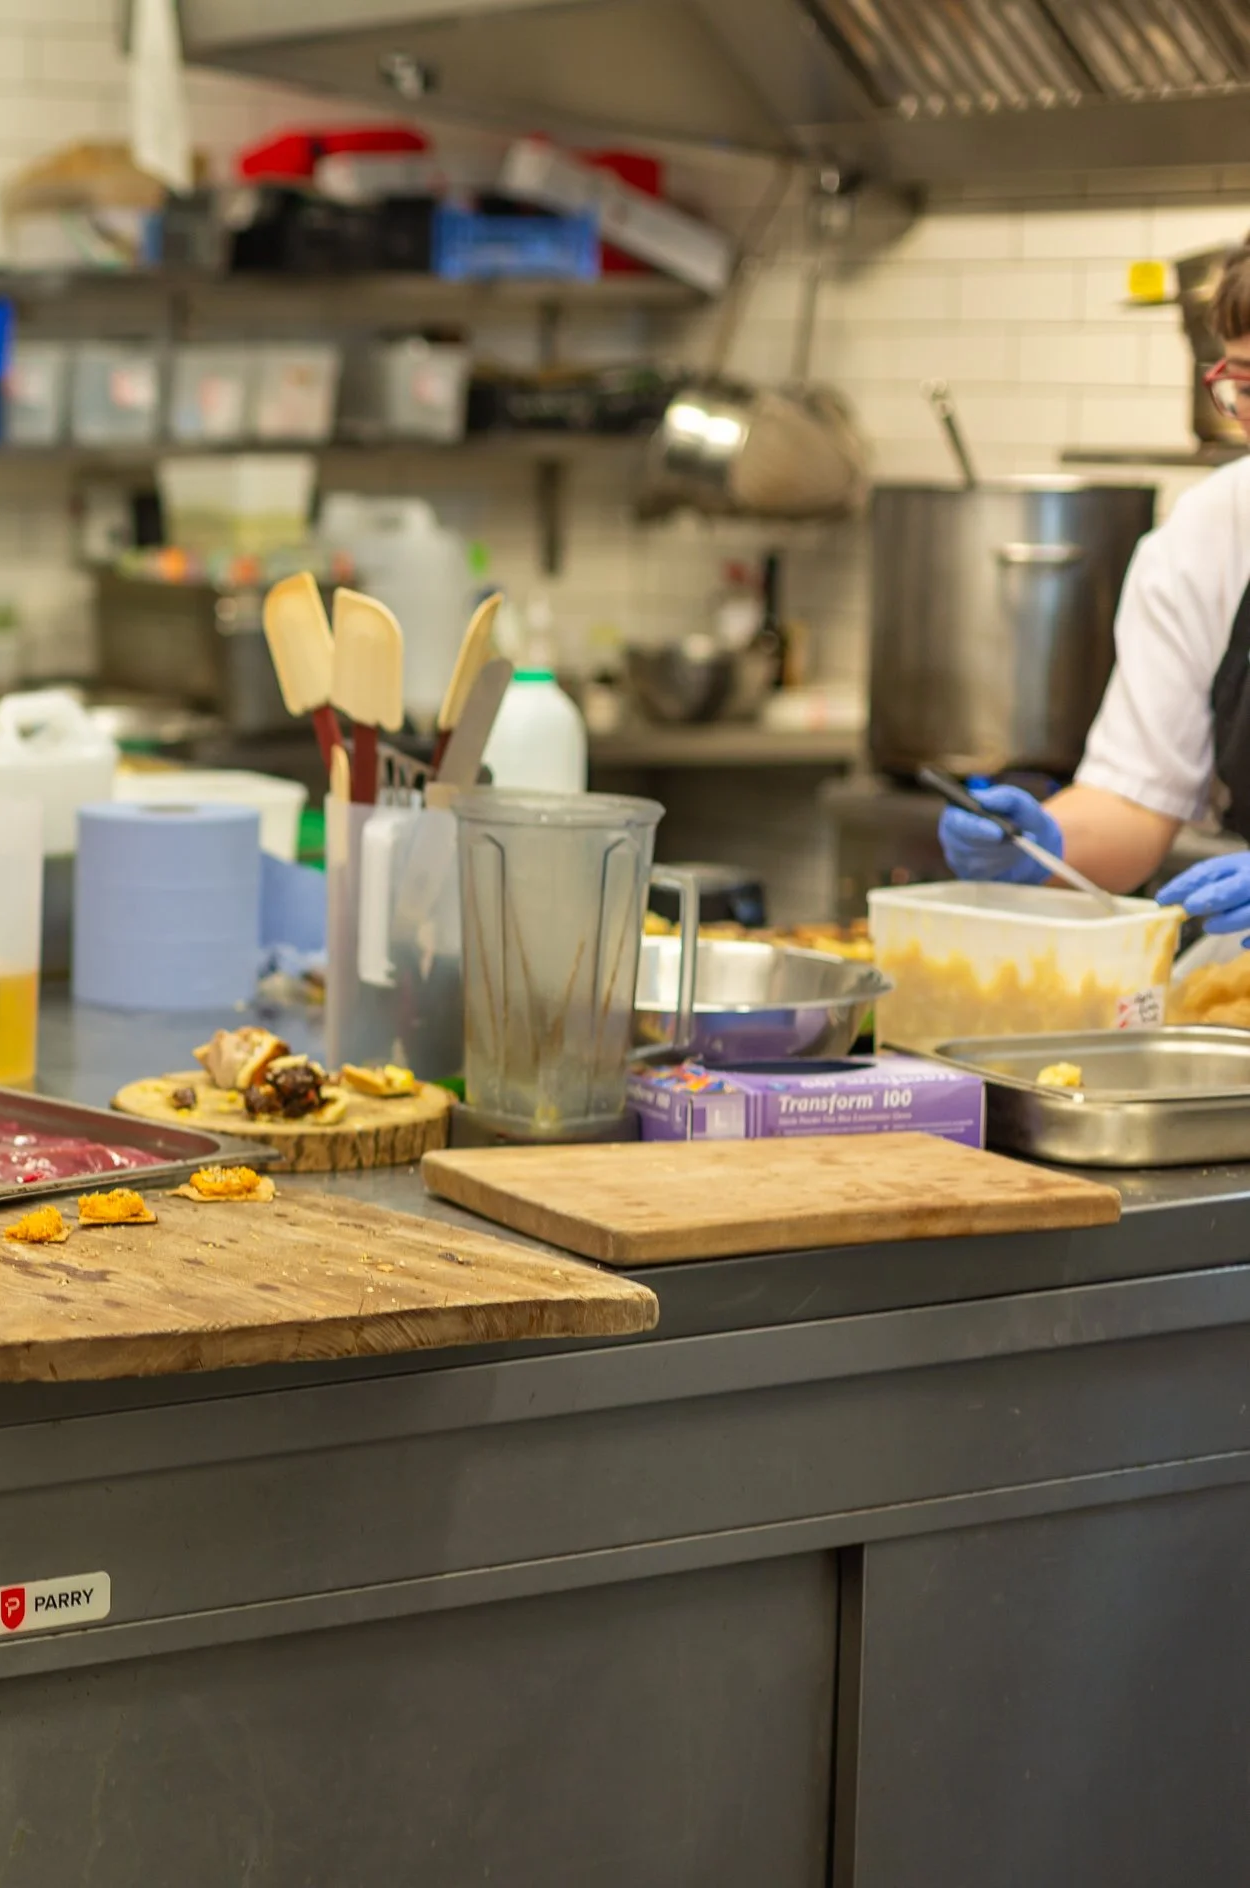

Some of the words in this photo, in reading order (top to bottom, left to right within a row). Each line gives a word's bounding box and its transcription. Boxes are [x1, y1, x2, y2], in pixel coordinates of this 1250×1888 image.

[778, 1091, 873, 1115] Transform
[882, 1088, 913, 1109] 100
[713, 1109, 729, 1130] L
[34, 1588, 94, 1612] PARRY
